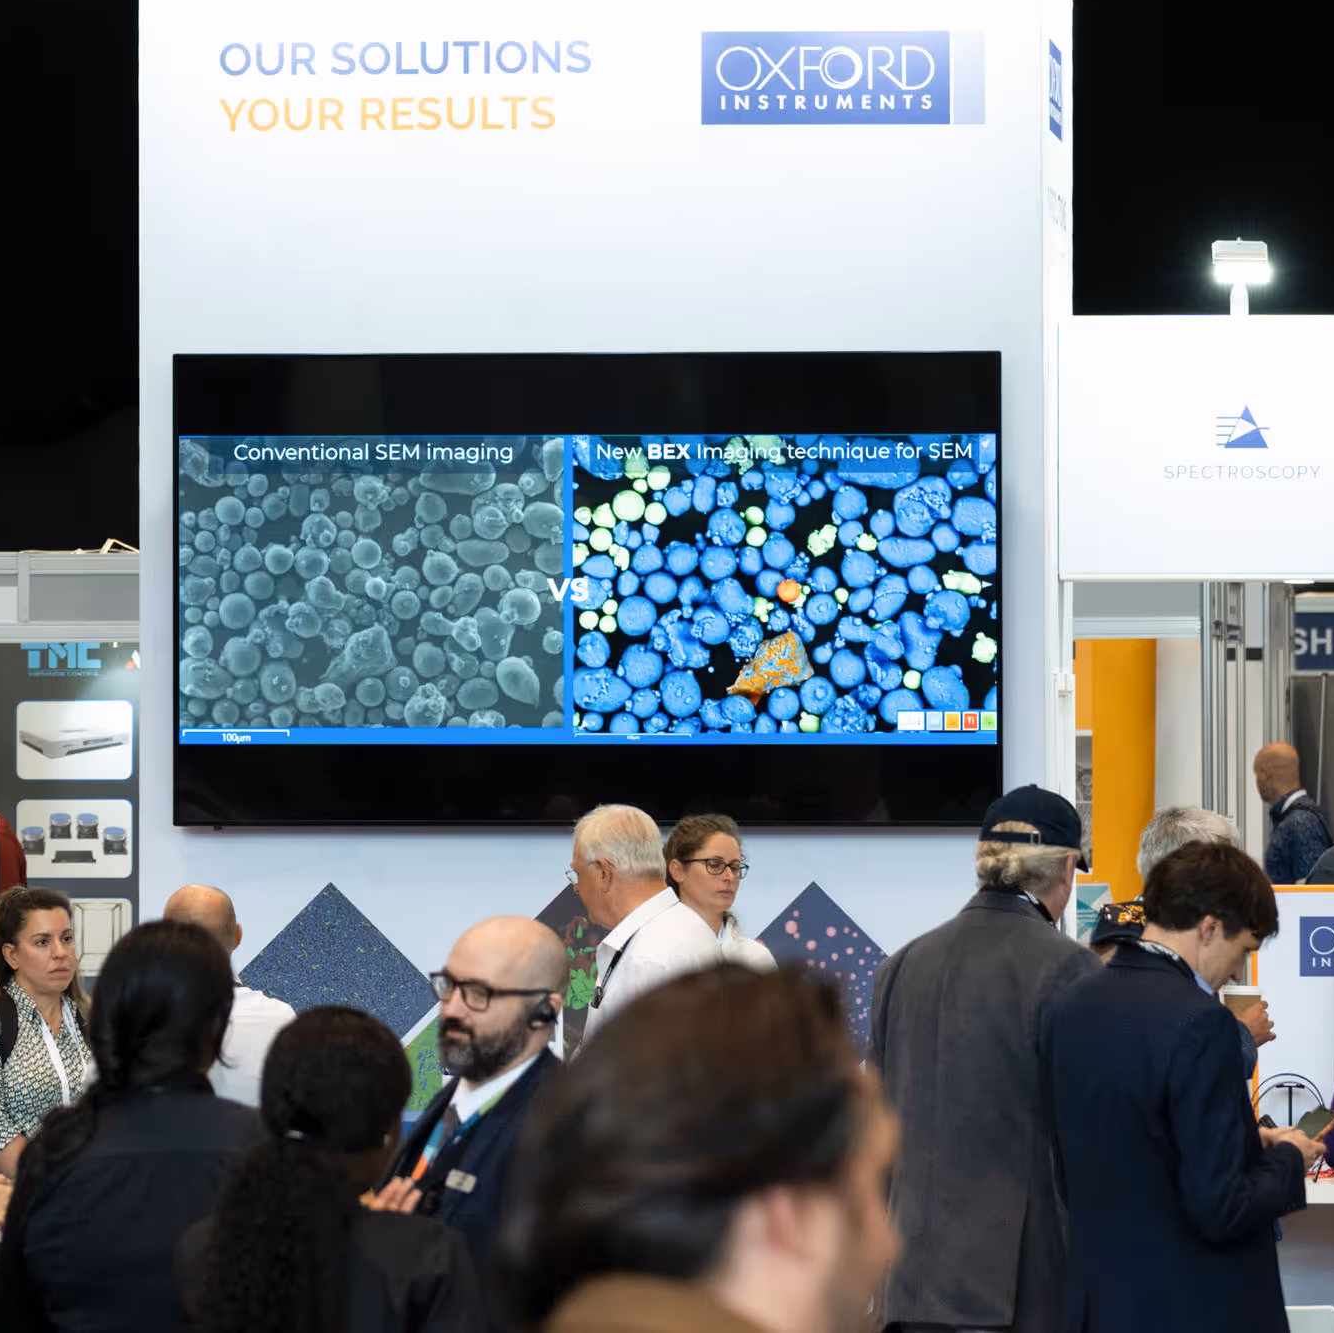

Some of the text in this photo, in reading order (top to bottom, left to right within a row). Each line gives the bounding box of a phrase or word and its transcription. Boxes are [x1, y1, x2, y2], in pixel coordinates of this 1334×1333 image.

[220, 40, 593, 77] OUR SOLUTIONS
[715, 45, 935, 92] OXFORD
[220, 96, 556, 132] YOUR RESULTS
[720, 93, 933, 111] INSTRUMENTS
[233, 443, 513, 464] Conventional SEM imaging
[596, 442, 973, 463] New BEX Imaging technique for SEM
[1163, 465, 1321, 480] SPECTROSCOPY
[20, 642, 102, 669] TMC
